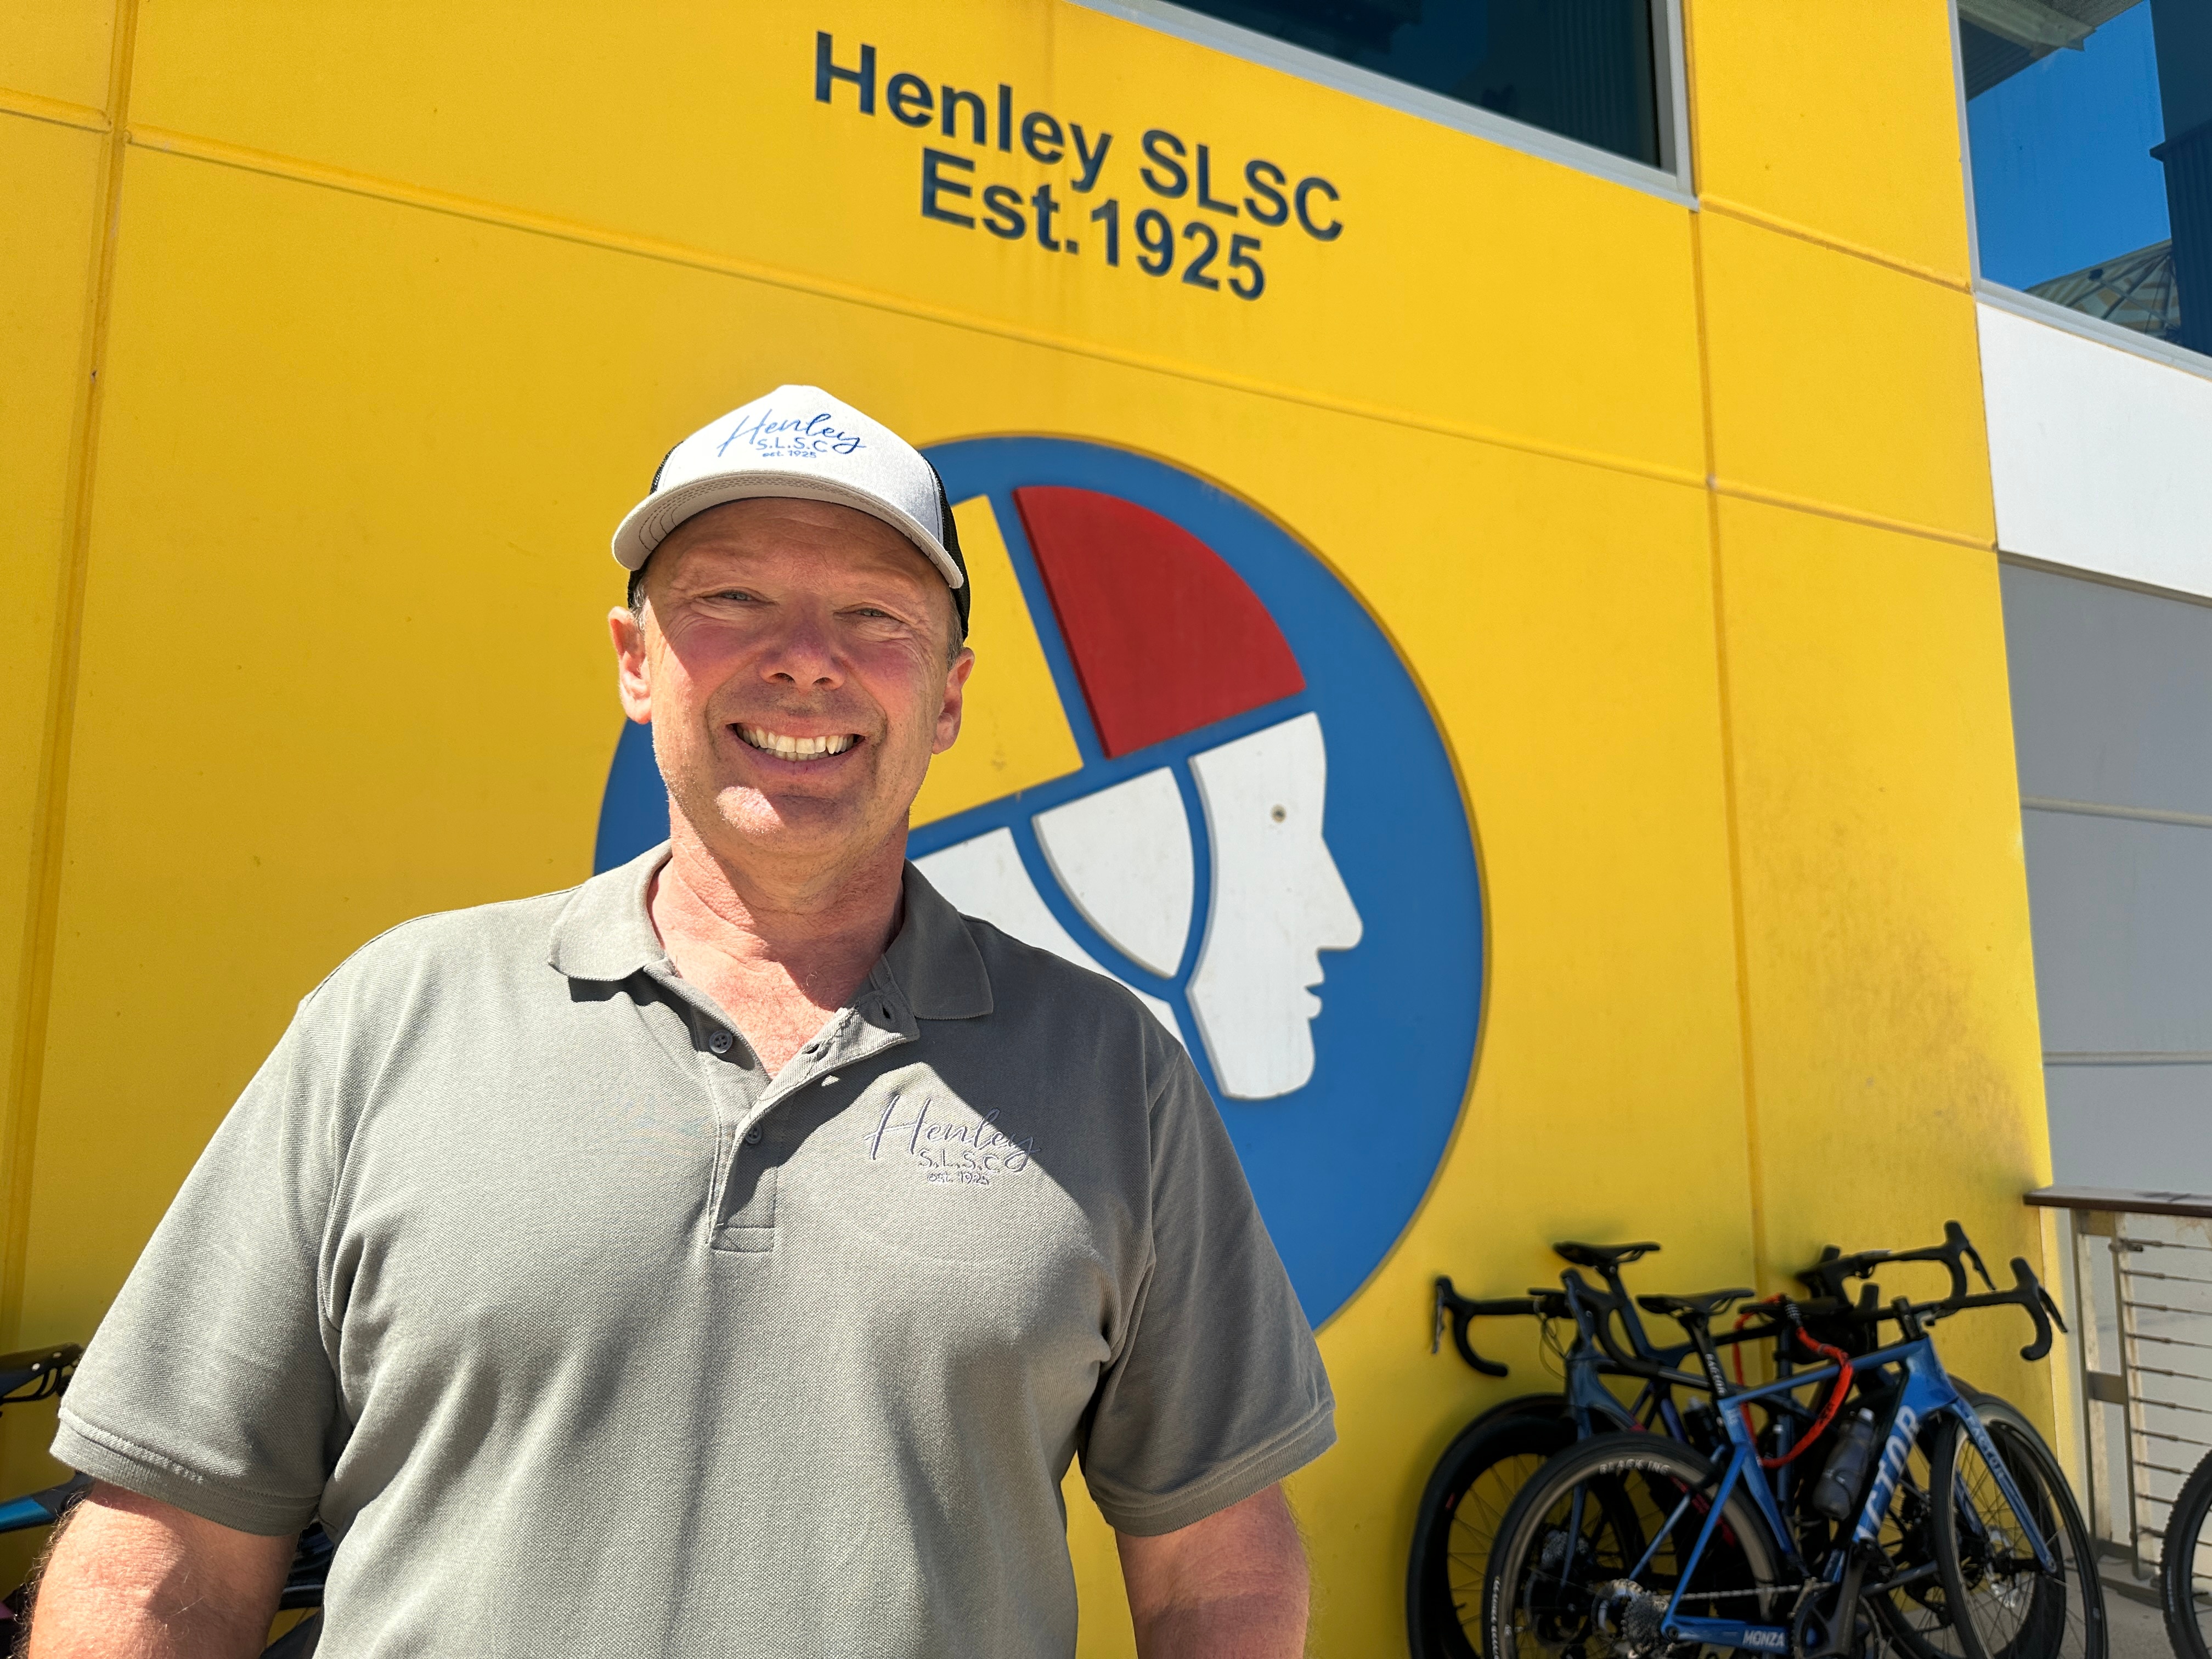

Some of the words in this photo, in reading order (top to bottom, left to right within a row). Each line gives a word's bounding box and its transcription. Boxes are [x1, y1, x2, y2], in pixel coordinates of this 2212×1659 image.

[815, 31, 1112, 193] Henley
[1139, 128, 1344, 242] SLSC
[921, 147, 1266, 301] Est.1925
[716, 409, 866, 457] Henley
[755, 437, 828, 453] S.L.S.C
[788, 450, 817, 458] 1925
[864, 1094, 1041, 1172] Henley
[960, 1172, 989, 1185] 1925
[1742, 1629, 1785, 1647] MONZA
